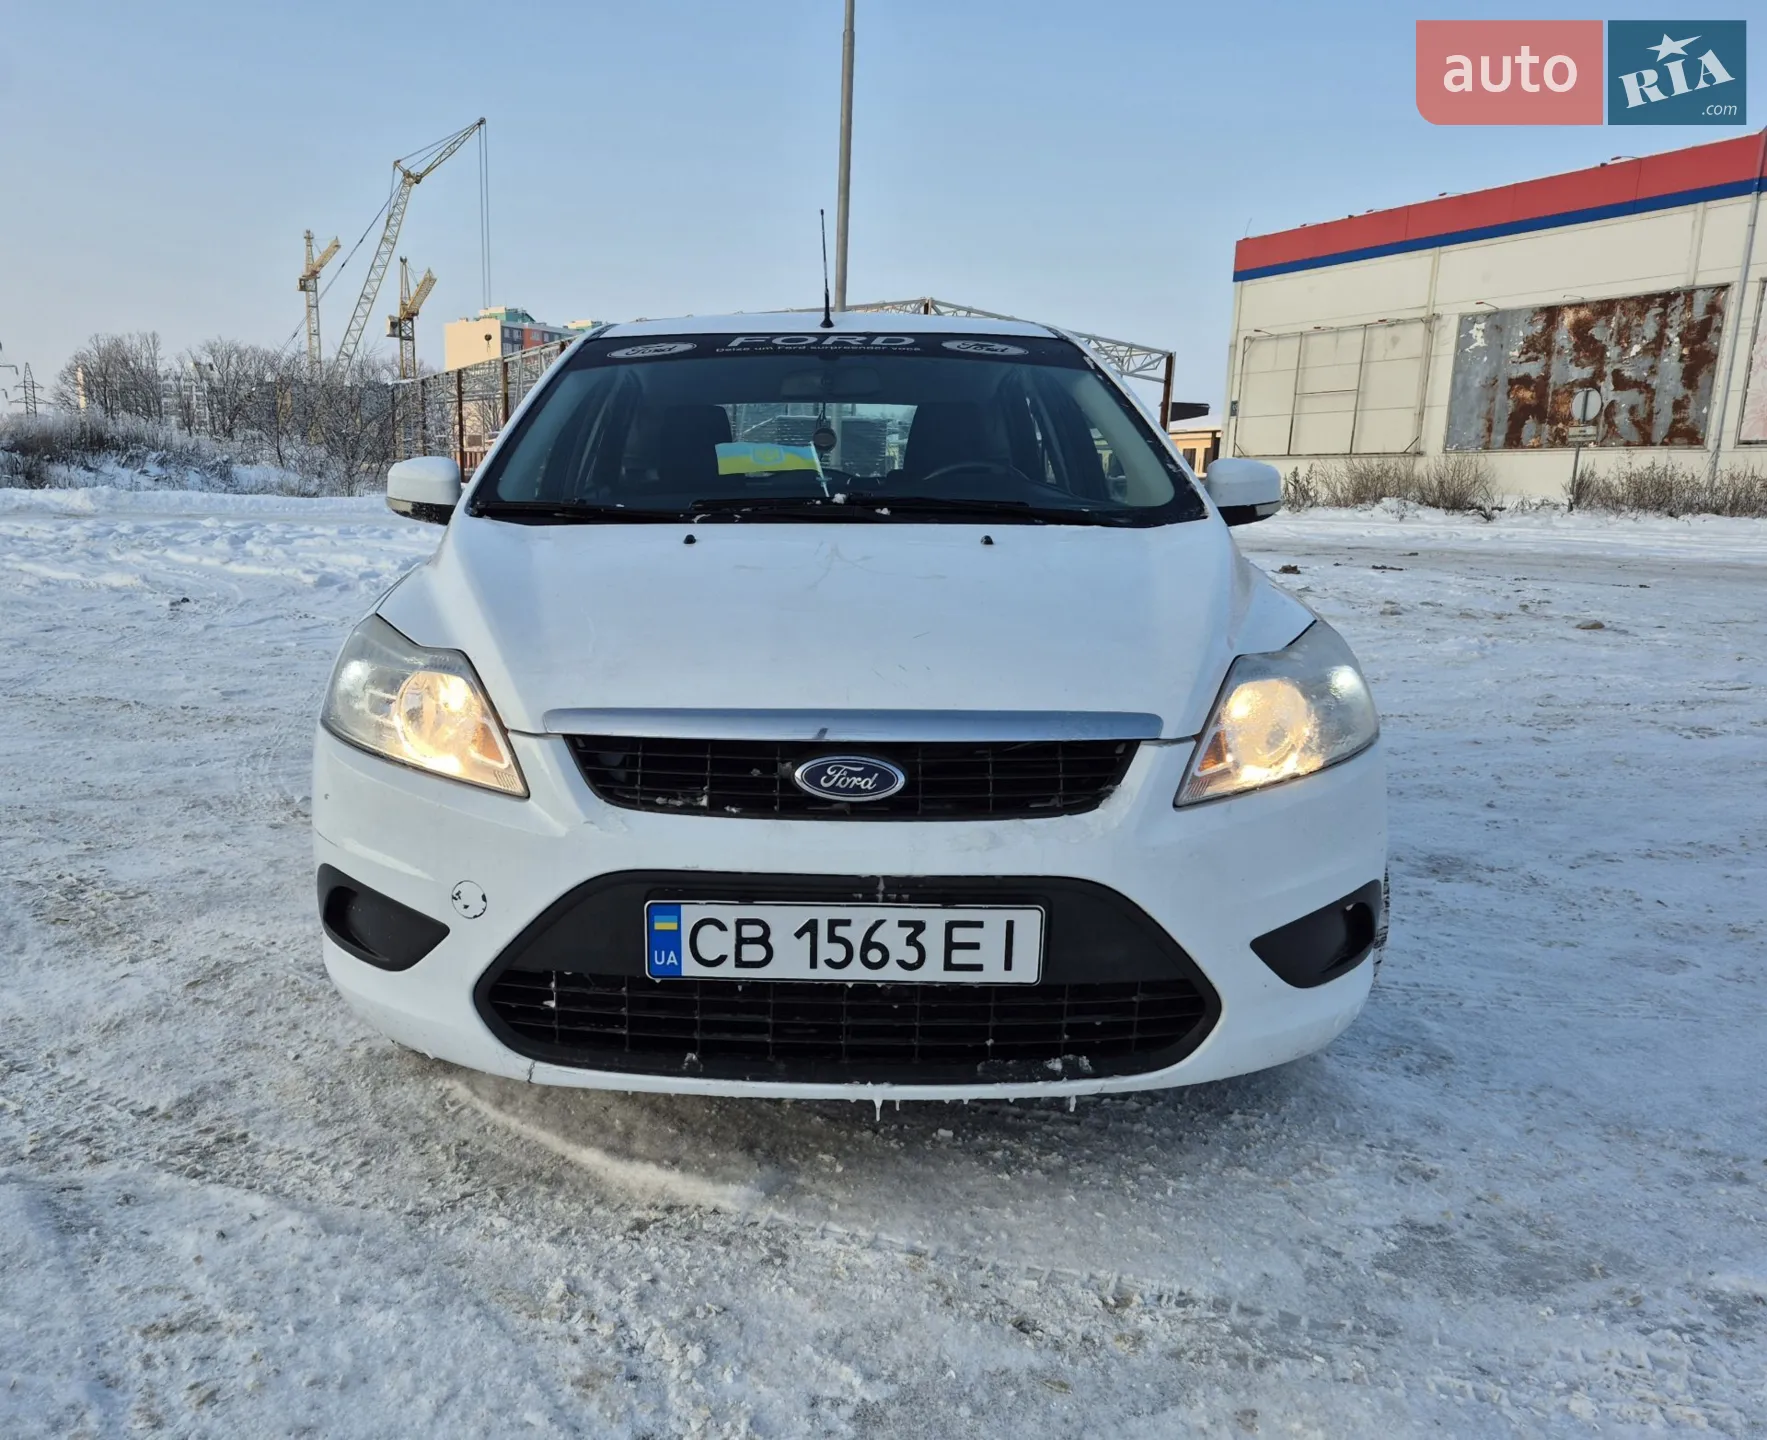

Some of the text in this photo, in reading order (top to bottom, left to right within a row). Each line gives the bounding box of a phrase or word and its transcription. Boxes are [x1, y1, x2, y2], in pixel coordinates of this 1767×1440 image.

[727, 335, 915, 347] FORD
[956, 341, 1009, 353] Ford
[625, 344, 678, 355] Ford
[820, 764, 880, 790] Ford
[688, 917, 1014, 972] CB 1563 EI
[654, 950, 679, 966] UA
